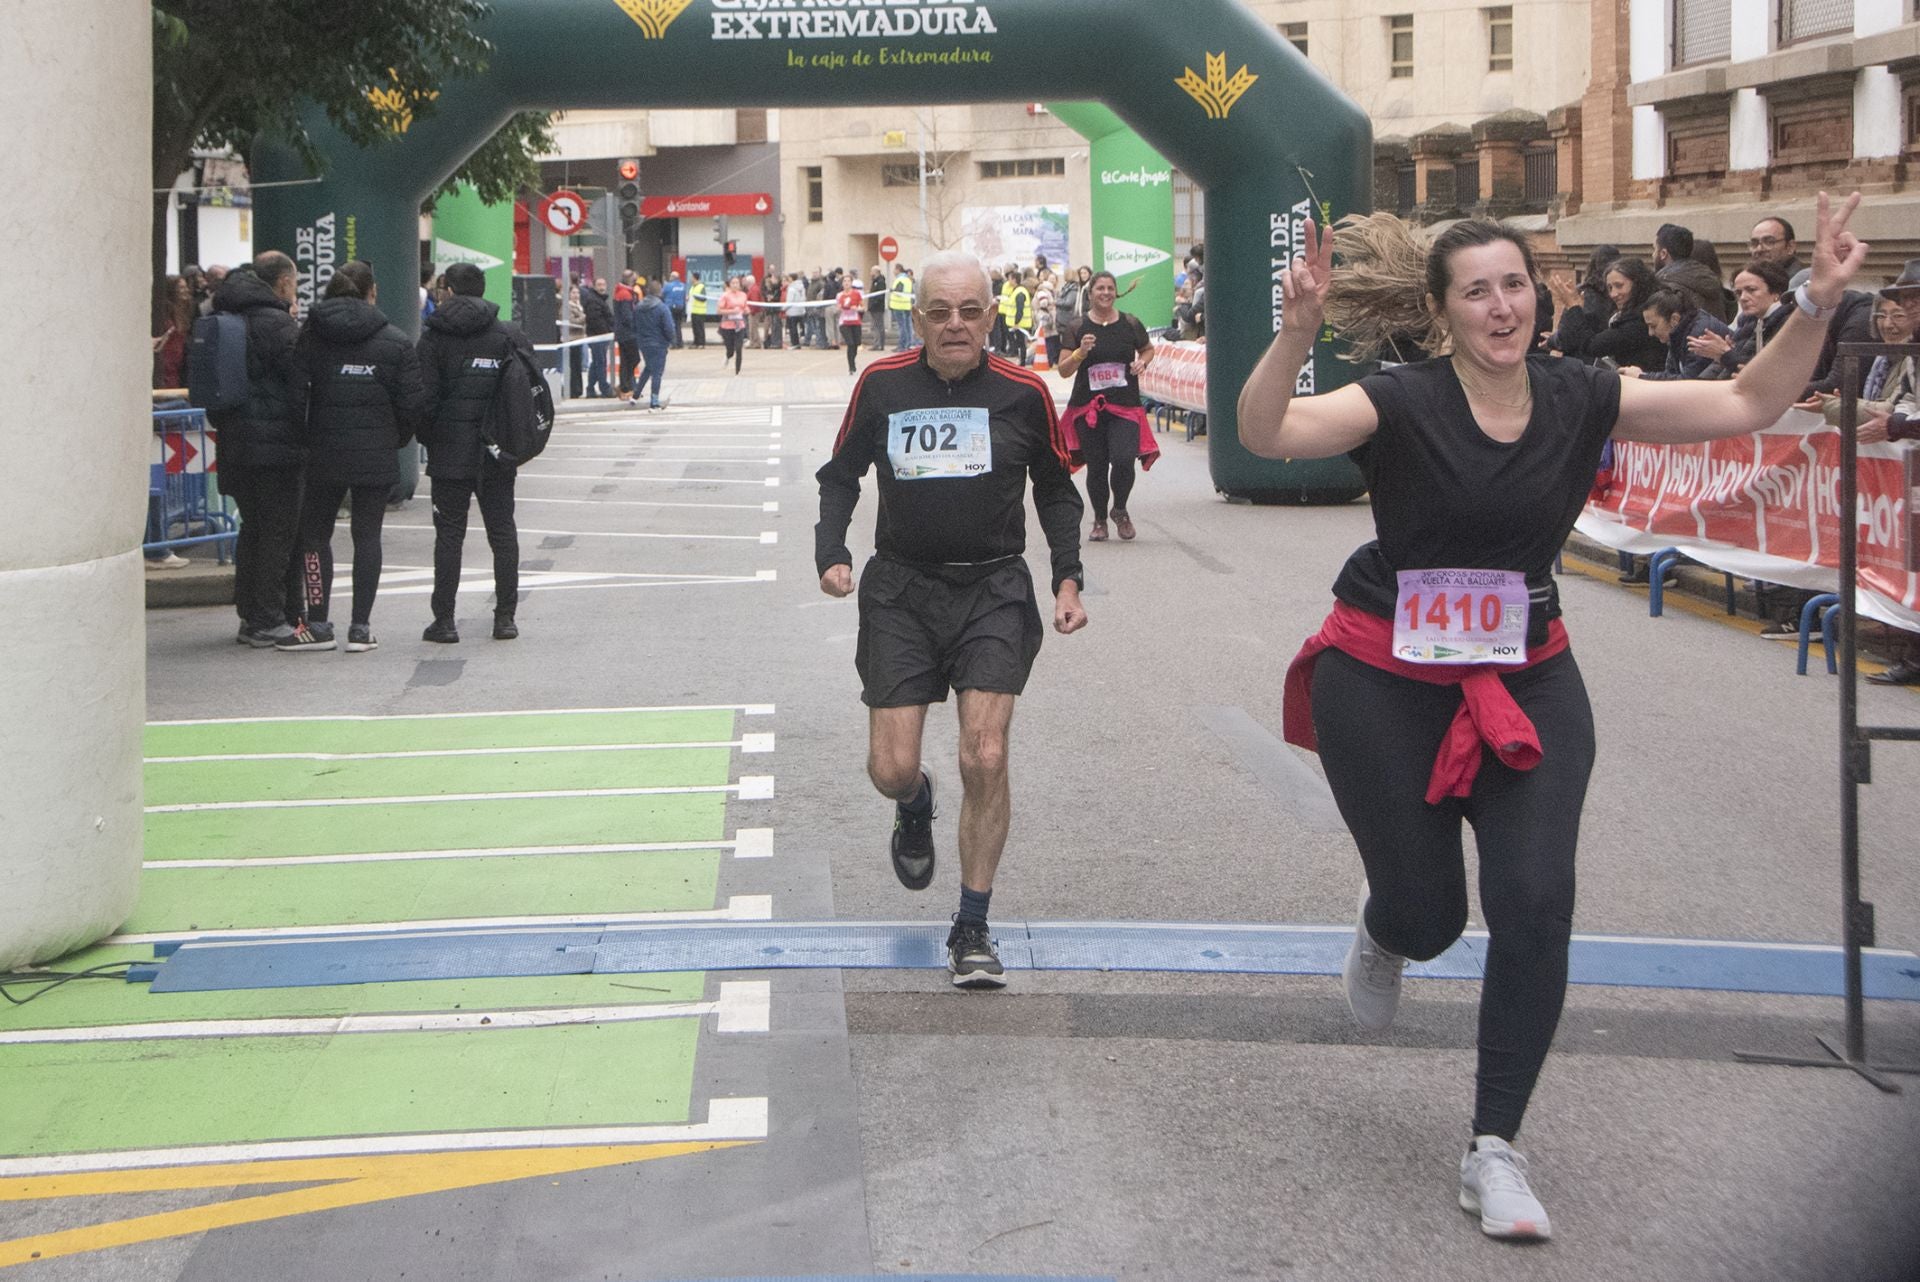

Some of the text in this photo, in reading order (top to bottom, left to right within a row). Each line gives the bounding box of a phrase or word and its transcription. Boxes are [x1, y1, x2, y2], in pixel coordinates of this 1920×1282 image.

[711, 6, 998, 40] EXTREMADURA
[811, 49, 847, 70] caja
[852, 49, 874, 65] de
[879, 47, 993, 65] Extremadura
[675, 201, 711, 212] Santander
[296, 226, 315, 261] DE
[1270, 213, 1290, 248] DE
[1090, 367, 1119, 382] 1684
[901, 423, 958, 454] 702
[964, 463, 986, 471] HOY
[1633, 444, 1664, 490] HOY
[1666, 451, 1702, 499] HOY
[1701, 458, 1751, 504] HOY
[1753, 463, 1807, 511] HOY
[305, 551, 323, 606] adidas
[1421, 577, 1451, 585] VUELTA
[1467, 577, 1506, 586] BALUARTE
[1404, 592, 1502, 632] 1410
[1492, 646, 1519, 655] HOY
